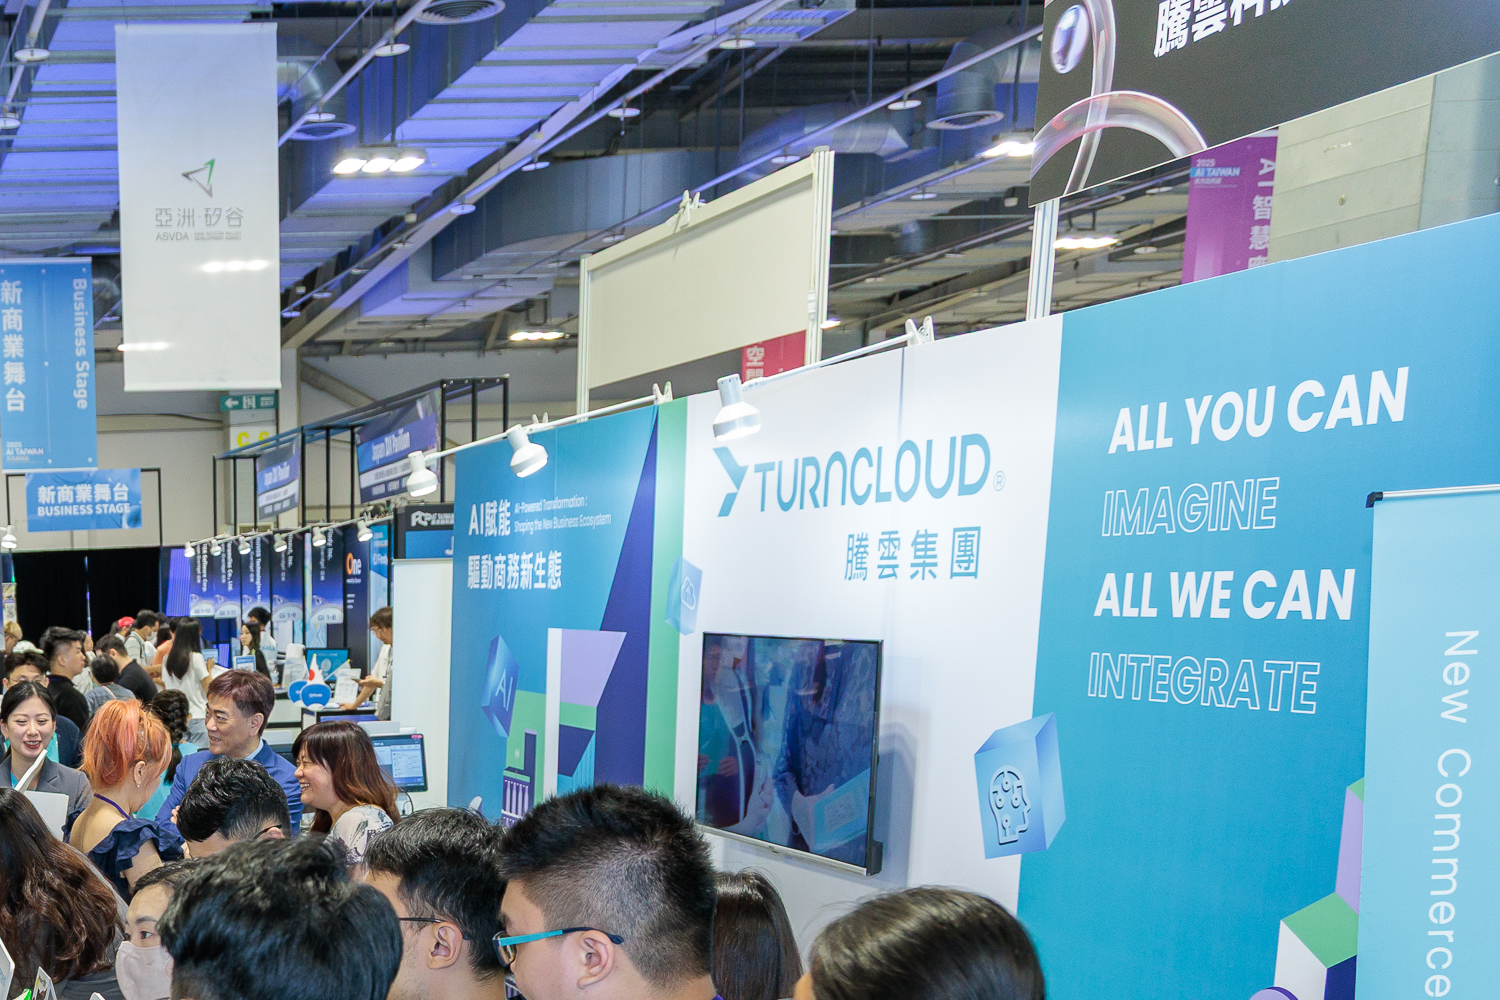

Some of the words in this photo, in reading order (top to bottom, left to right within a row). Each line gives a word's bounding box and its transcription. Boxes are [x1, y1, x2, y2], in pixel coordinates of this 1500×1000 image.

[1153, 0, 1291, 58] 騰雲
[1206, 167, 1240, 177] TAIWAN
[155, 232, 189, 241] ASVDA
[72, 278, 88, 357] Business
[0, 279, 26, 412] 新商業舞台
[73, 360, 90, 409] Stage
[1107, 401, 1174, 454] ALL
[1184, 385, 1276, 445] YOU
[1287, 366, 1409, 433] CAN
[37, 504, 93, 517] BUSINESS
[95, 503, 131, 515] STAGE
[38, 482, 129, 504] 新商業舞台
[469, 499, 511, 537] AI賦能
[1101, 477, 1280, 537] IMAGINE
[553, 515, 579, 529] Business
[580, 513, 612, 530] Ecosystem
[346, 552, 362, 575] One
[467, 550, 562, 590] 驅動商務新生態
[845, 526, 981, 580] 騰雲集團
[1093, 572, 1157, 618] ALL
[1169, 571, 1234, 619] WE
[1243, 568, 1356, 620] CAN
[495, 668, 513, 711] AI
[1087, 652, 1320, 715] INTEGRATE
[1440, 630, 1480, 724] New
[1424, 748, 1472, 998] Commerce
